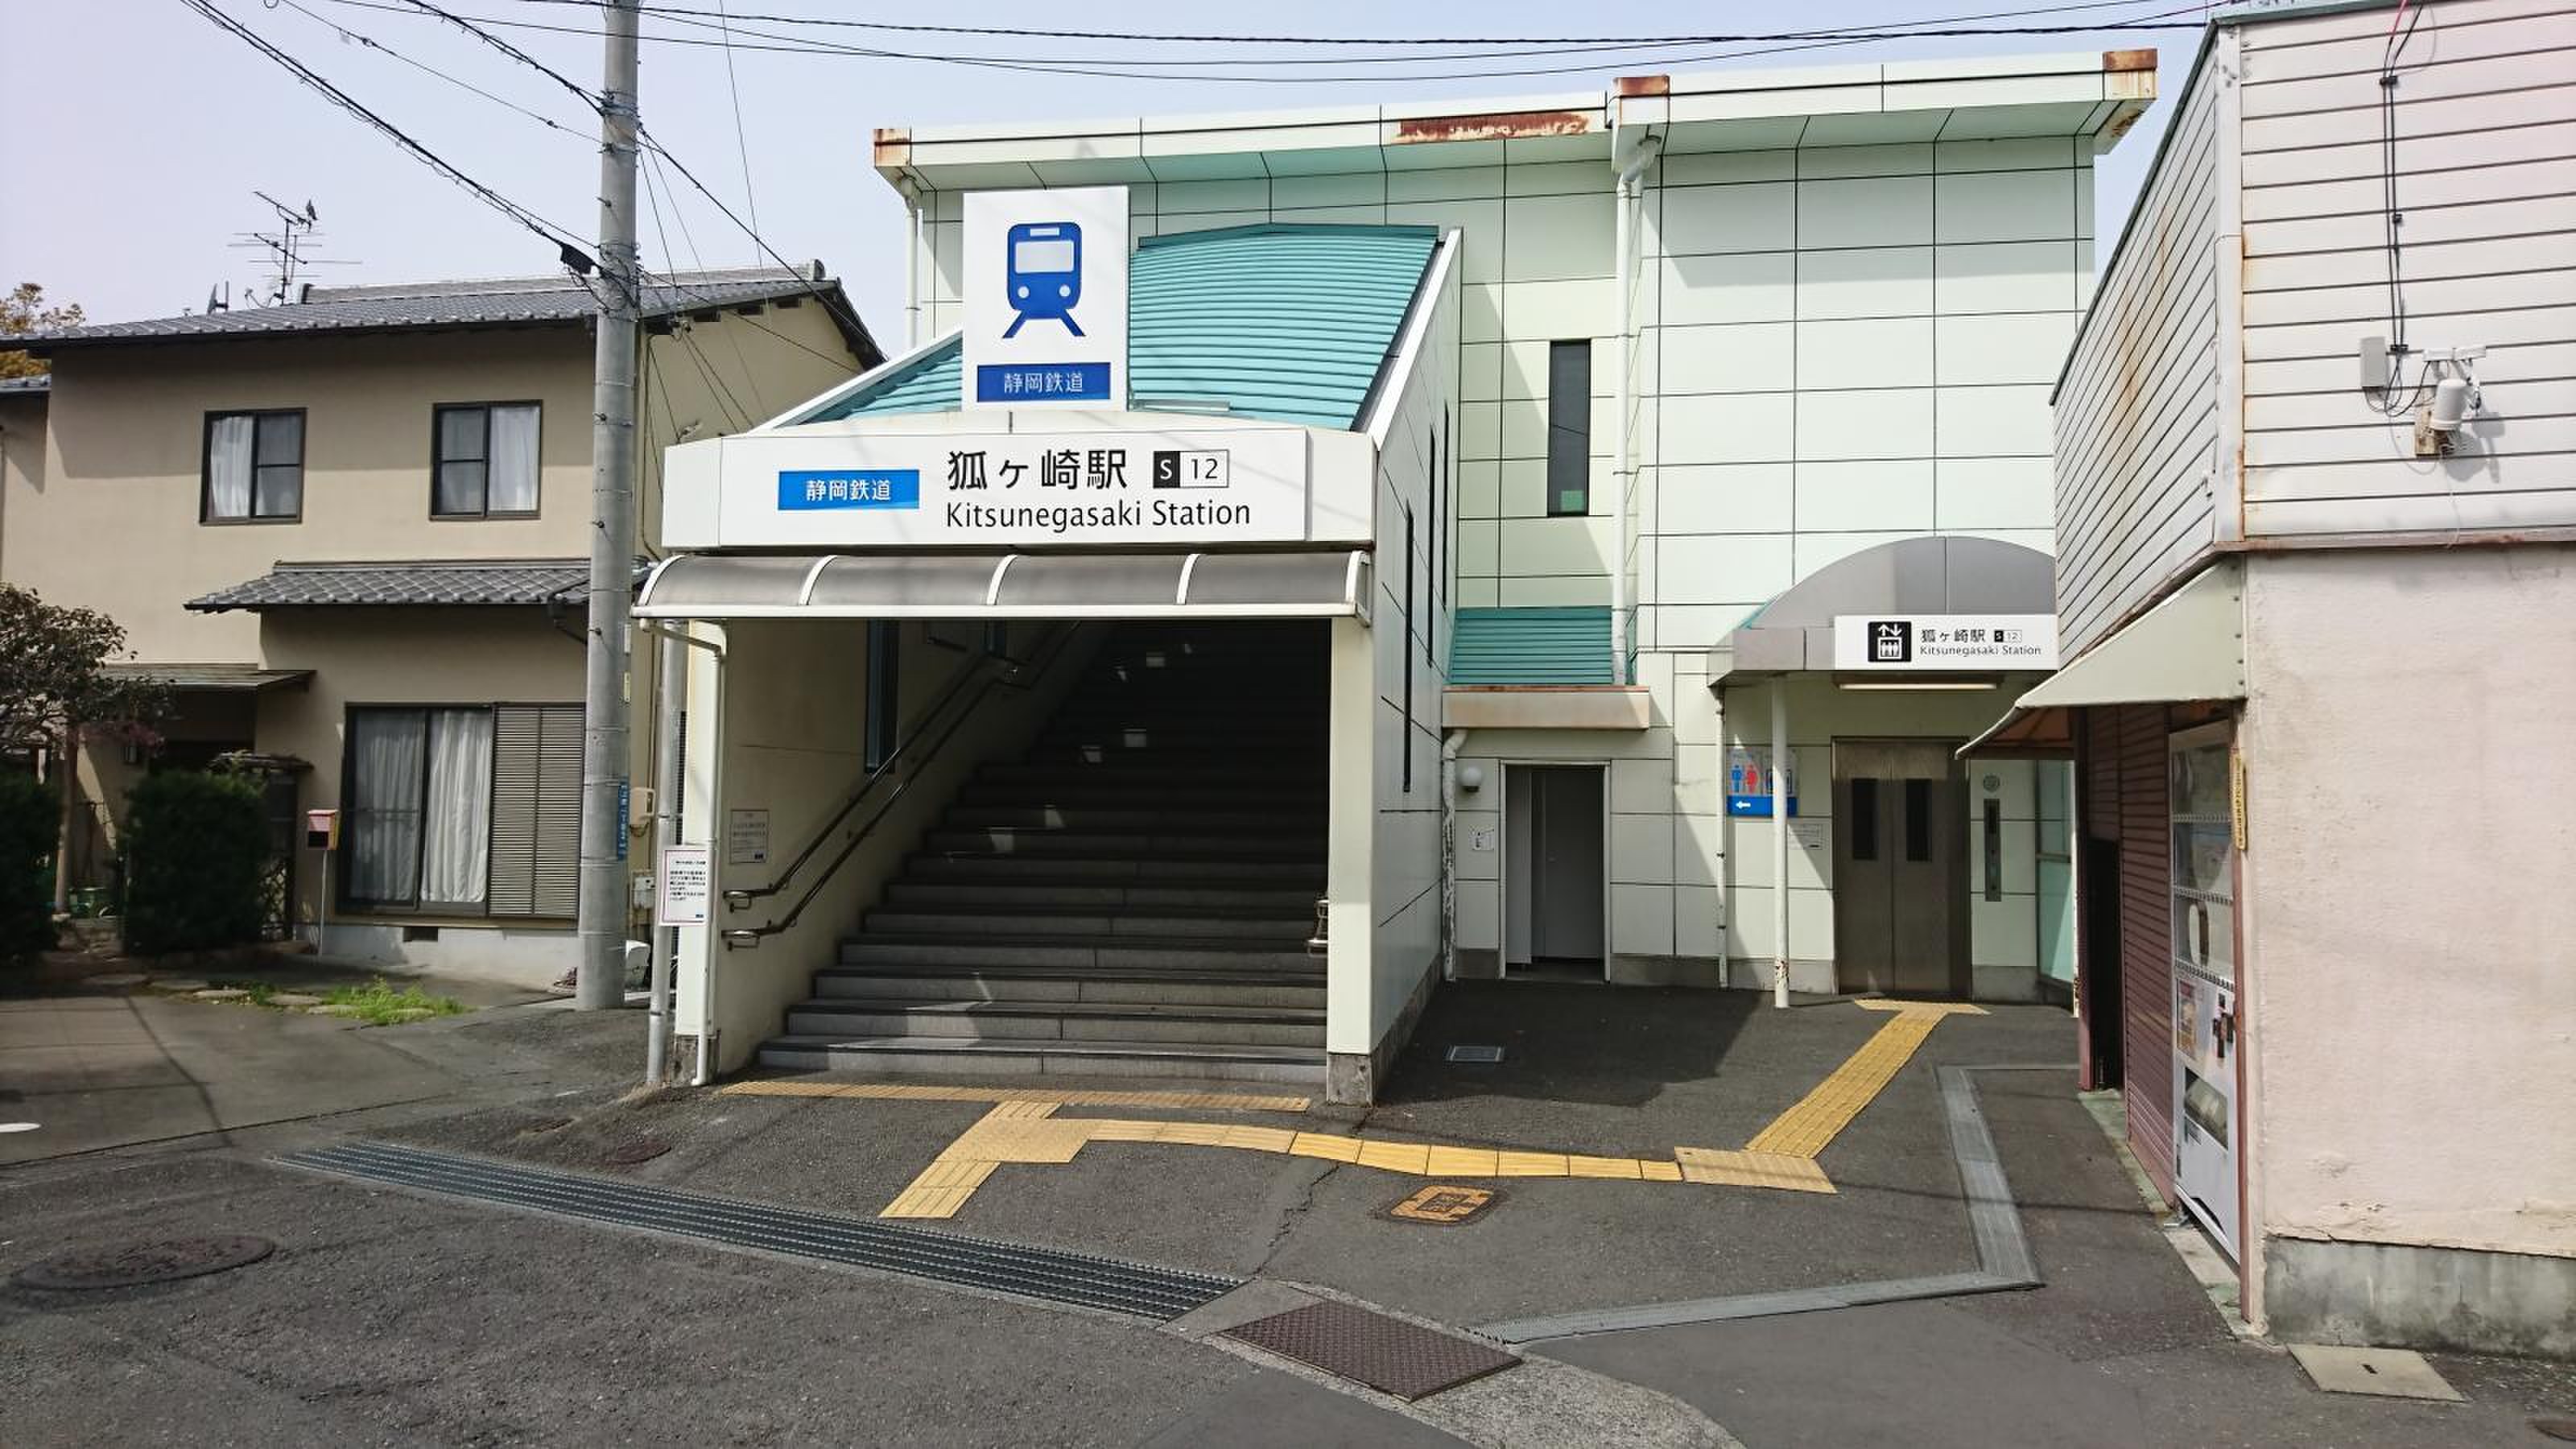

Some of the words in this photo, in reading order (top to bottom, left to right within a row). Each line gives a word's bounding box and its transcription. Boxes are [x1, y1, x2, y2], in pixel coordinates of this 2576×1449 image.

[1004, 372, 1083, 394] 静岡鉄道
[947, 448, 1128, 489] 狐ヶ崎駅
[1159, 458, 1173, 481] S
[1191, 457, 1219, 480] 12
[806, 479, 891, 502] 静岡鉄道
[947, 498, 1141, 534] Kitsunegasaki
[1152, 498, 1250, 526] Station
[2006, 631, 2020, 641] 12
[1919, 645, 1999, 658] Kitsunegasaki
[2001, 645, 2041, 655] Station
